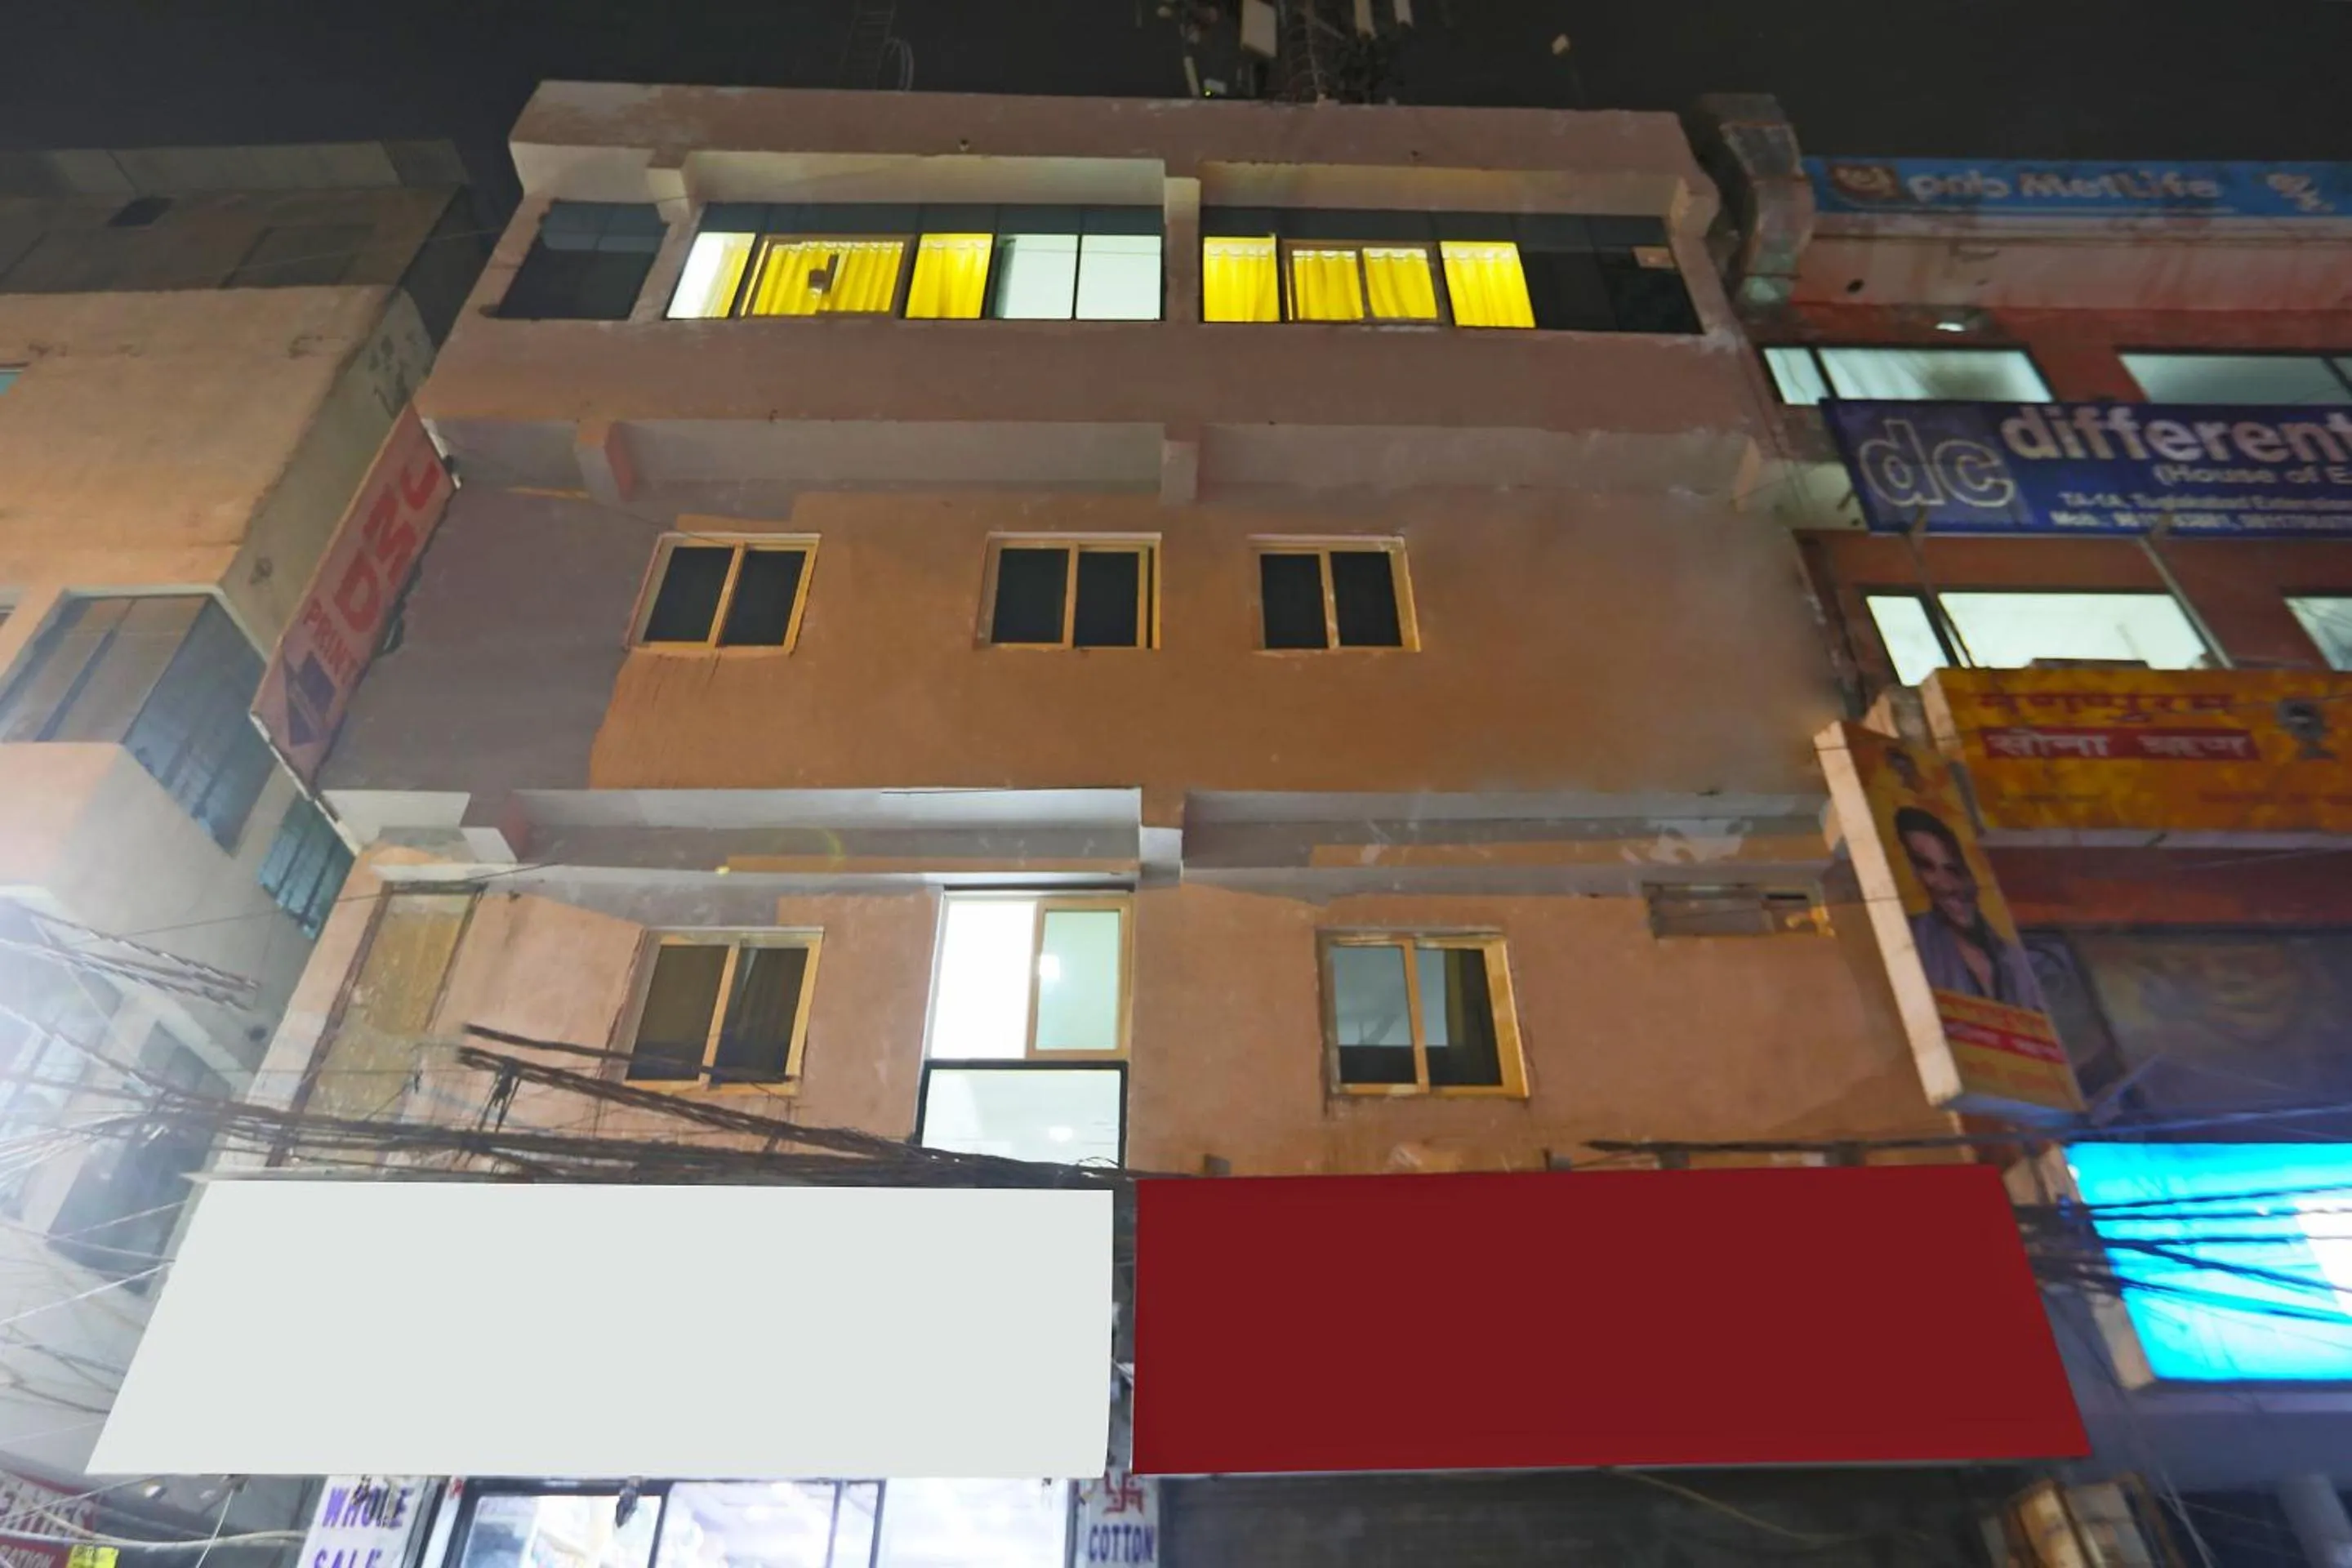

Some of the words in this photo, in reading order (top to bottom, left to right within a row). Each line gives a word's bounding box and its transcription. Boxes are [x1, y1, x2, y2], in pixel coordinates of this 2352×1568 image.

[2018, 171, 2221, 200] MetLife
[1858, 418, 2016, 508] dc
[1087, 1523, 1156, 1564] COTTON
